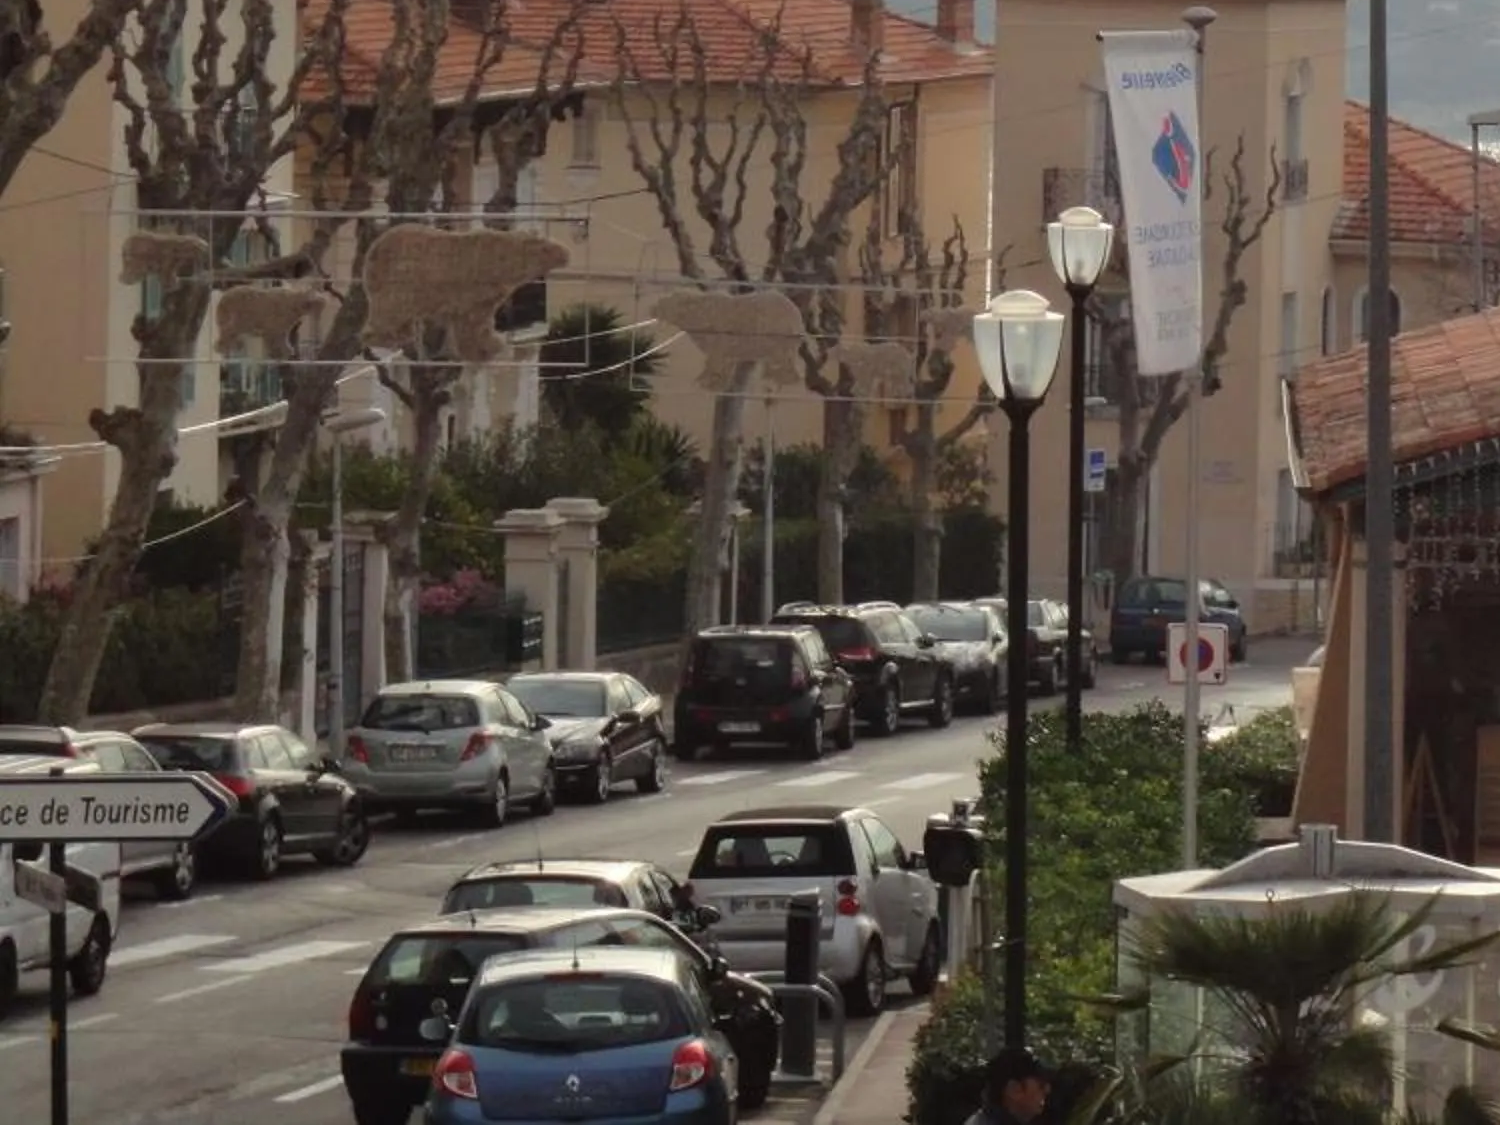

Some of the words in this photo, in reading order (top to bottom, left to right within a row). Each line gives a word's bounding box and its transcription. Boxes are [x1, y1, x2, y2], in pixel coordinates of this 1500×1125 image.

[0, 803, 28, 825] ce
[40, 797, 69, 825] de
[81, 795, 189, 824] Tourisme
